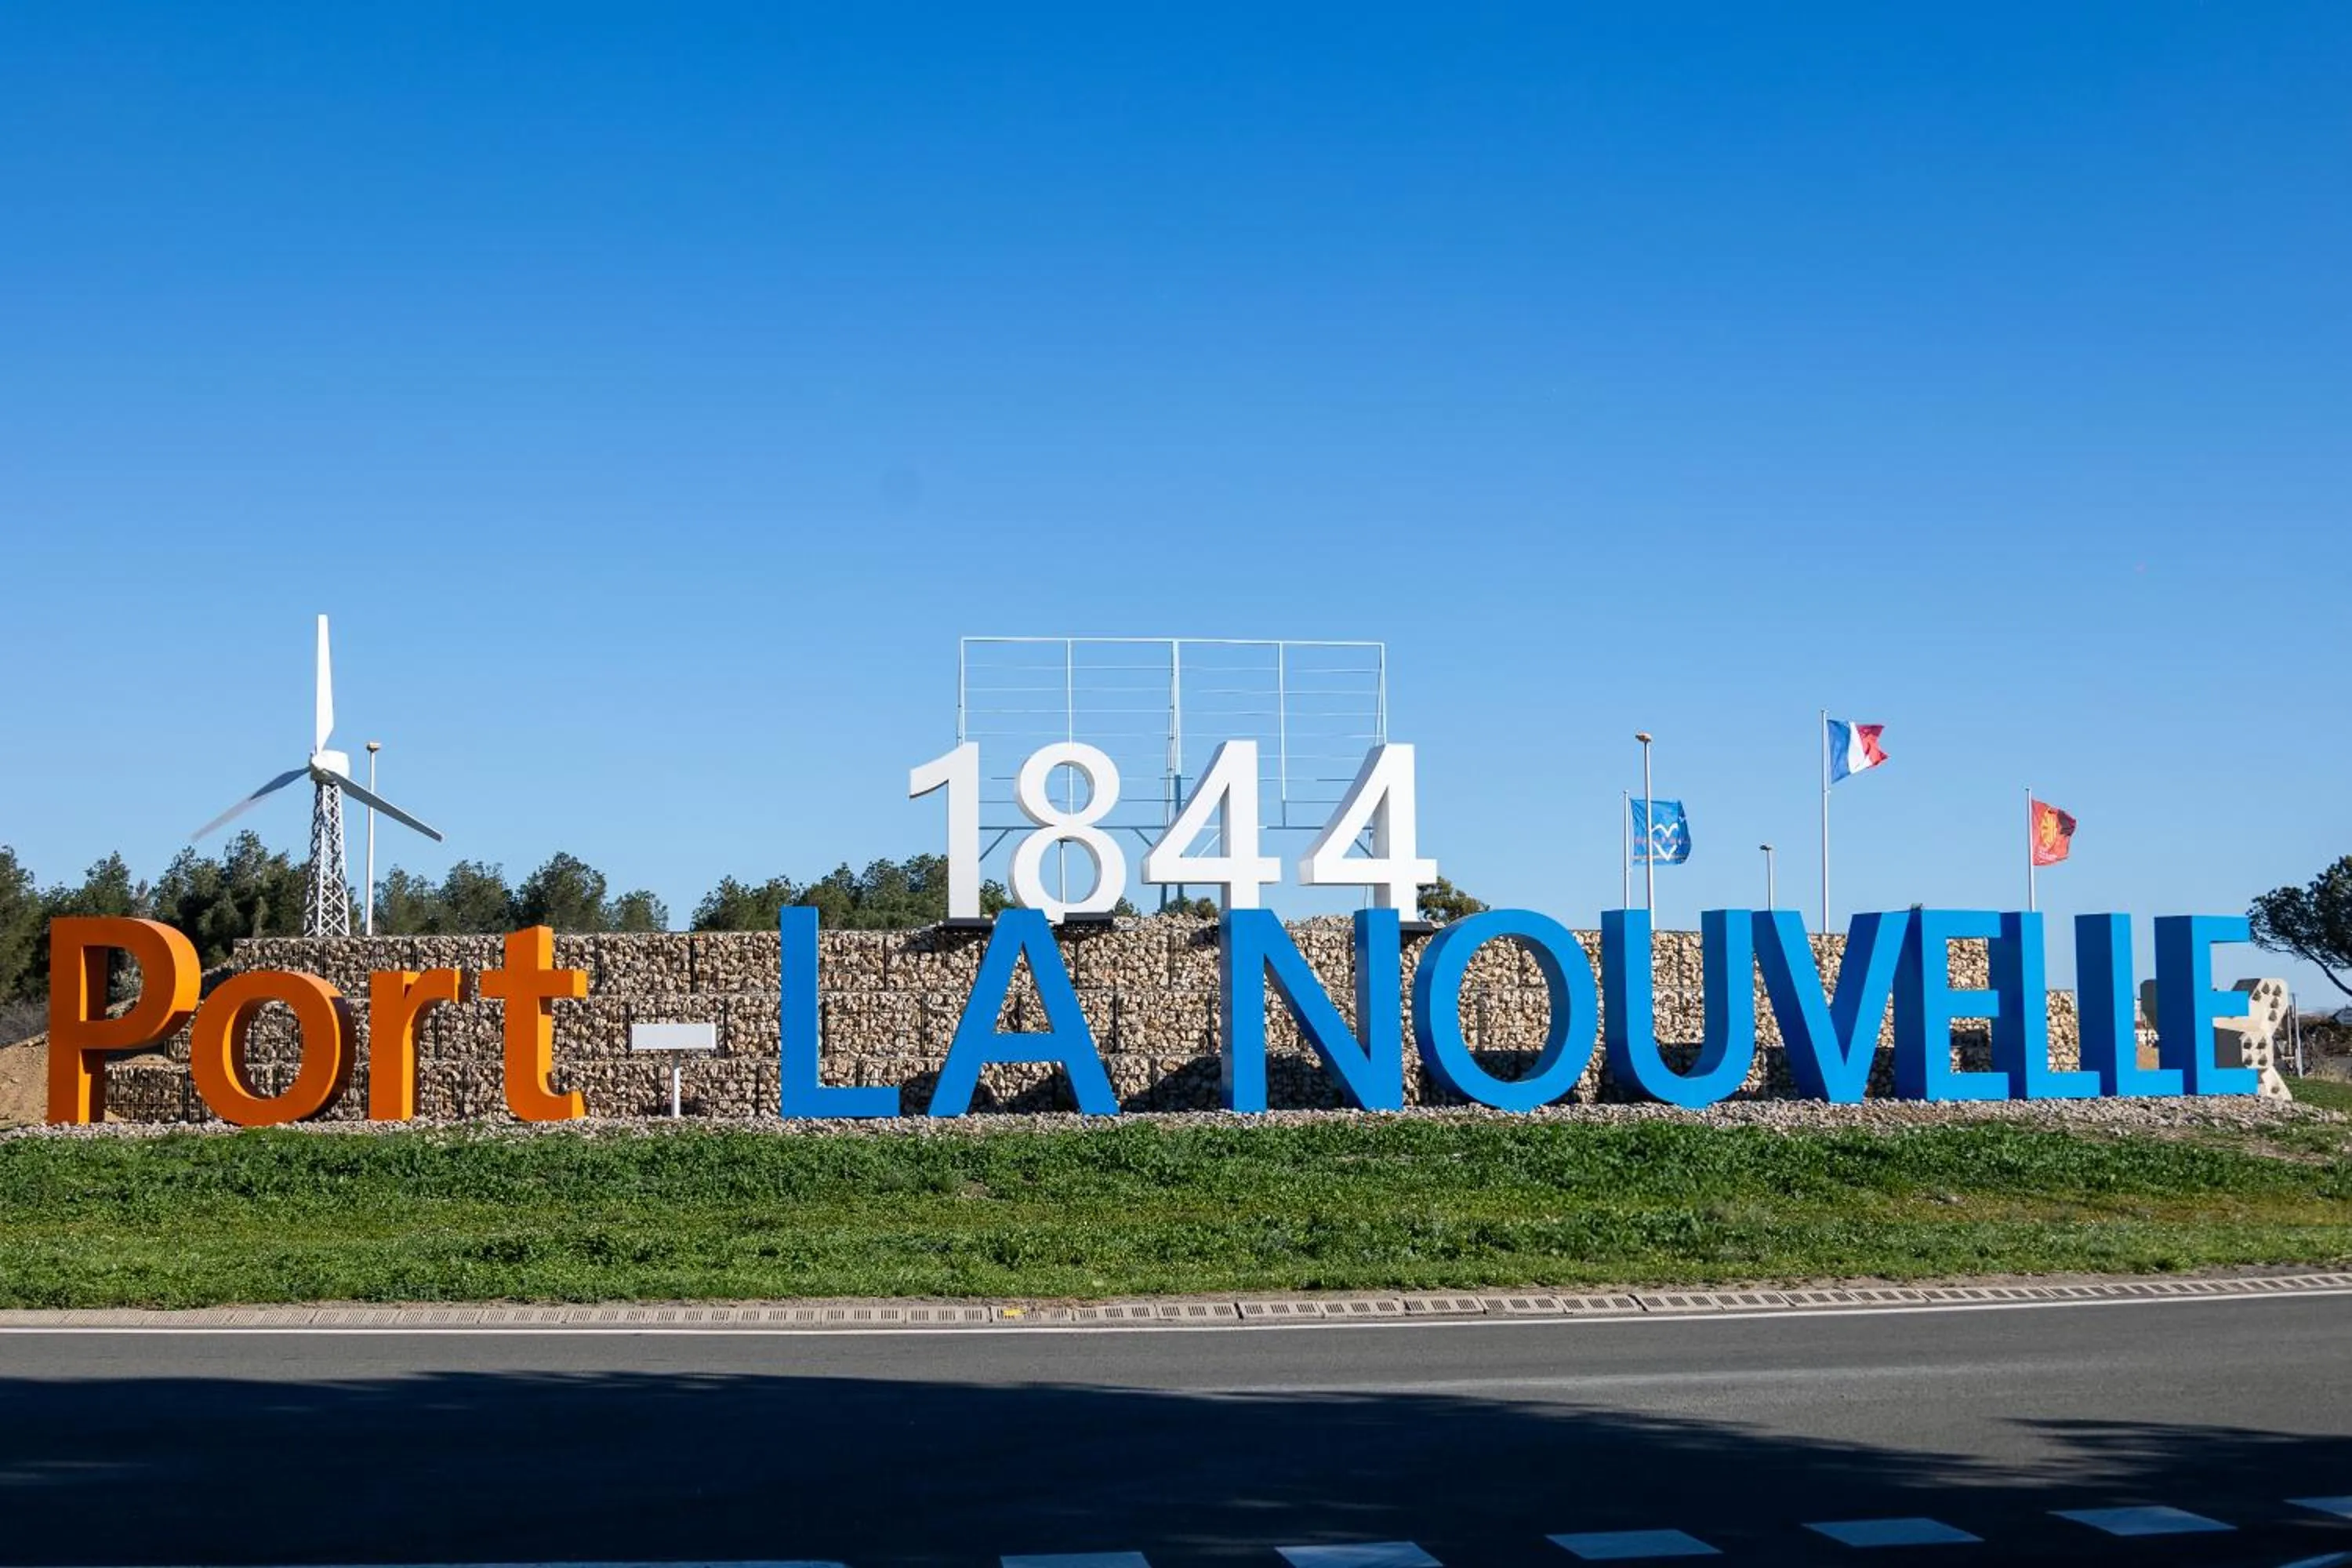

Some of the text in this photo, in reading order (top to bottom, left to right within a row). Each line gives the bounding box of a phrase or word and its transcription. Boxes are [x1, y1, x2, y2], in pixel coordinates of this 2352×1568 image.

[909, 740, 1437, 924] 1844
[780, 906, 1120, 1119] LA
[1220, 908, 2259, 1113] NOUVELLE
